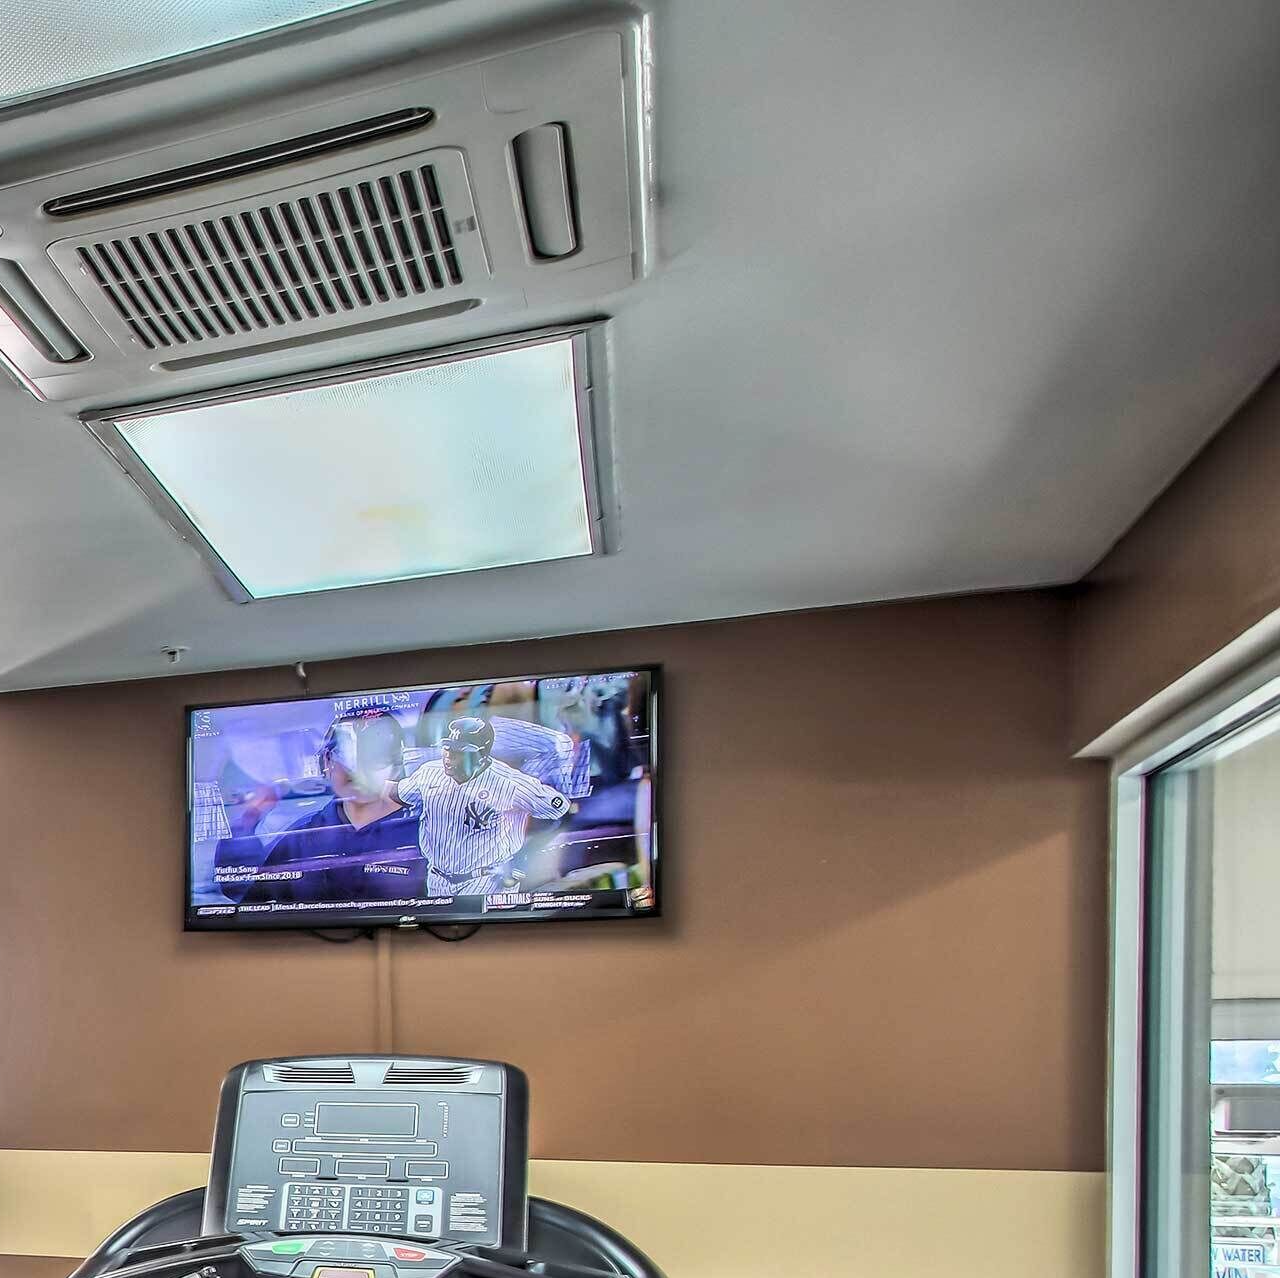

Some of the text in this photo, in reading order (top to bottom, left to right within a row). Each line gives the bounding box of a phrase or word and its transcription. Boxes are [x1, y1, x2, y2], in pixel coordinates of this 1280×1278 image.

[334, 694, 389, 711] MERRILL
[391, 703, 420, 711] COMPANY
[508, 893, 531, 905] FINALS
[335, 901, 355, 909] reach
[358, 900, 397, 910] agreement
[237, 1218, 269, 1226] SPIRIT
[1222, 1248, 1262, 1264] WATER
